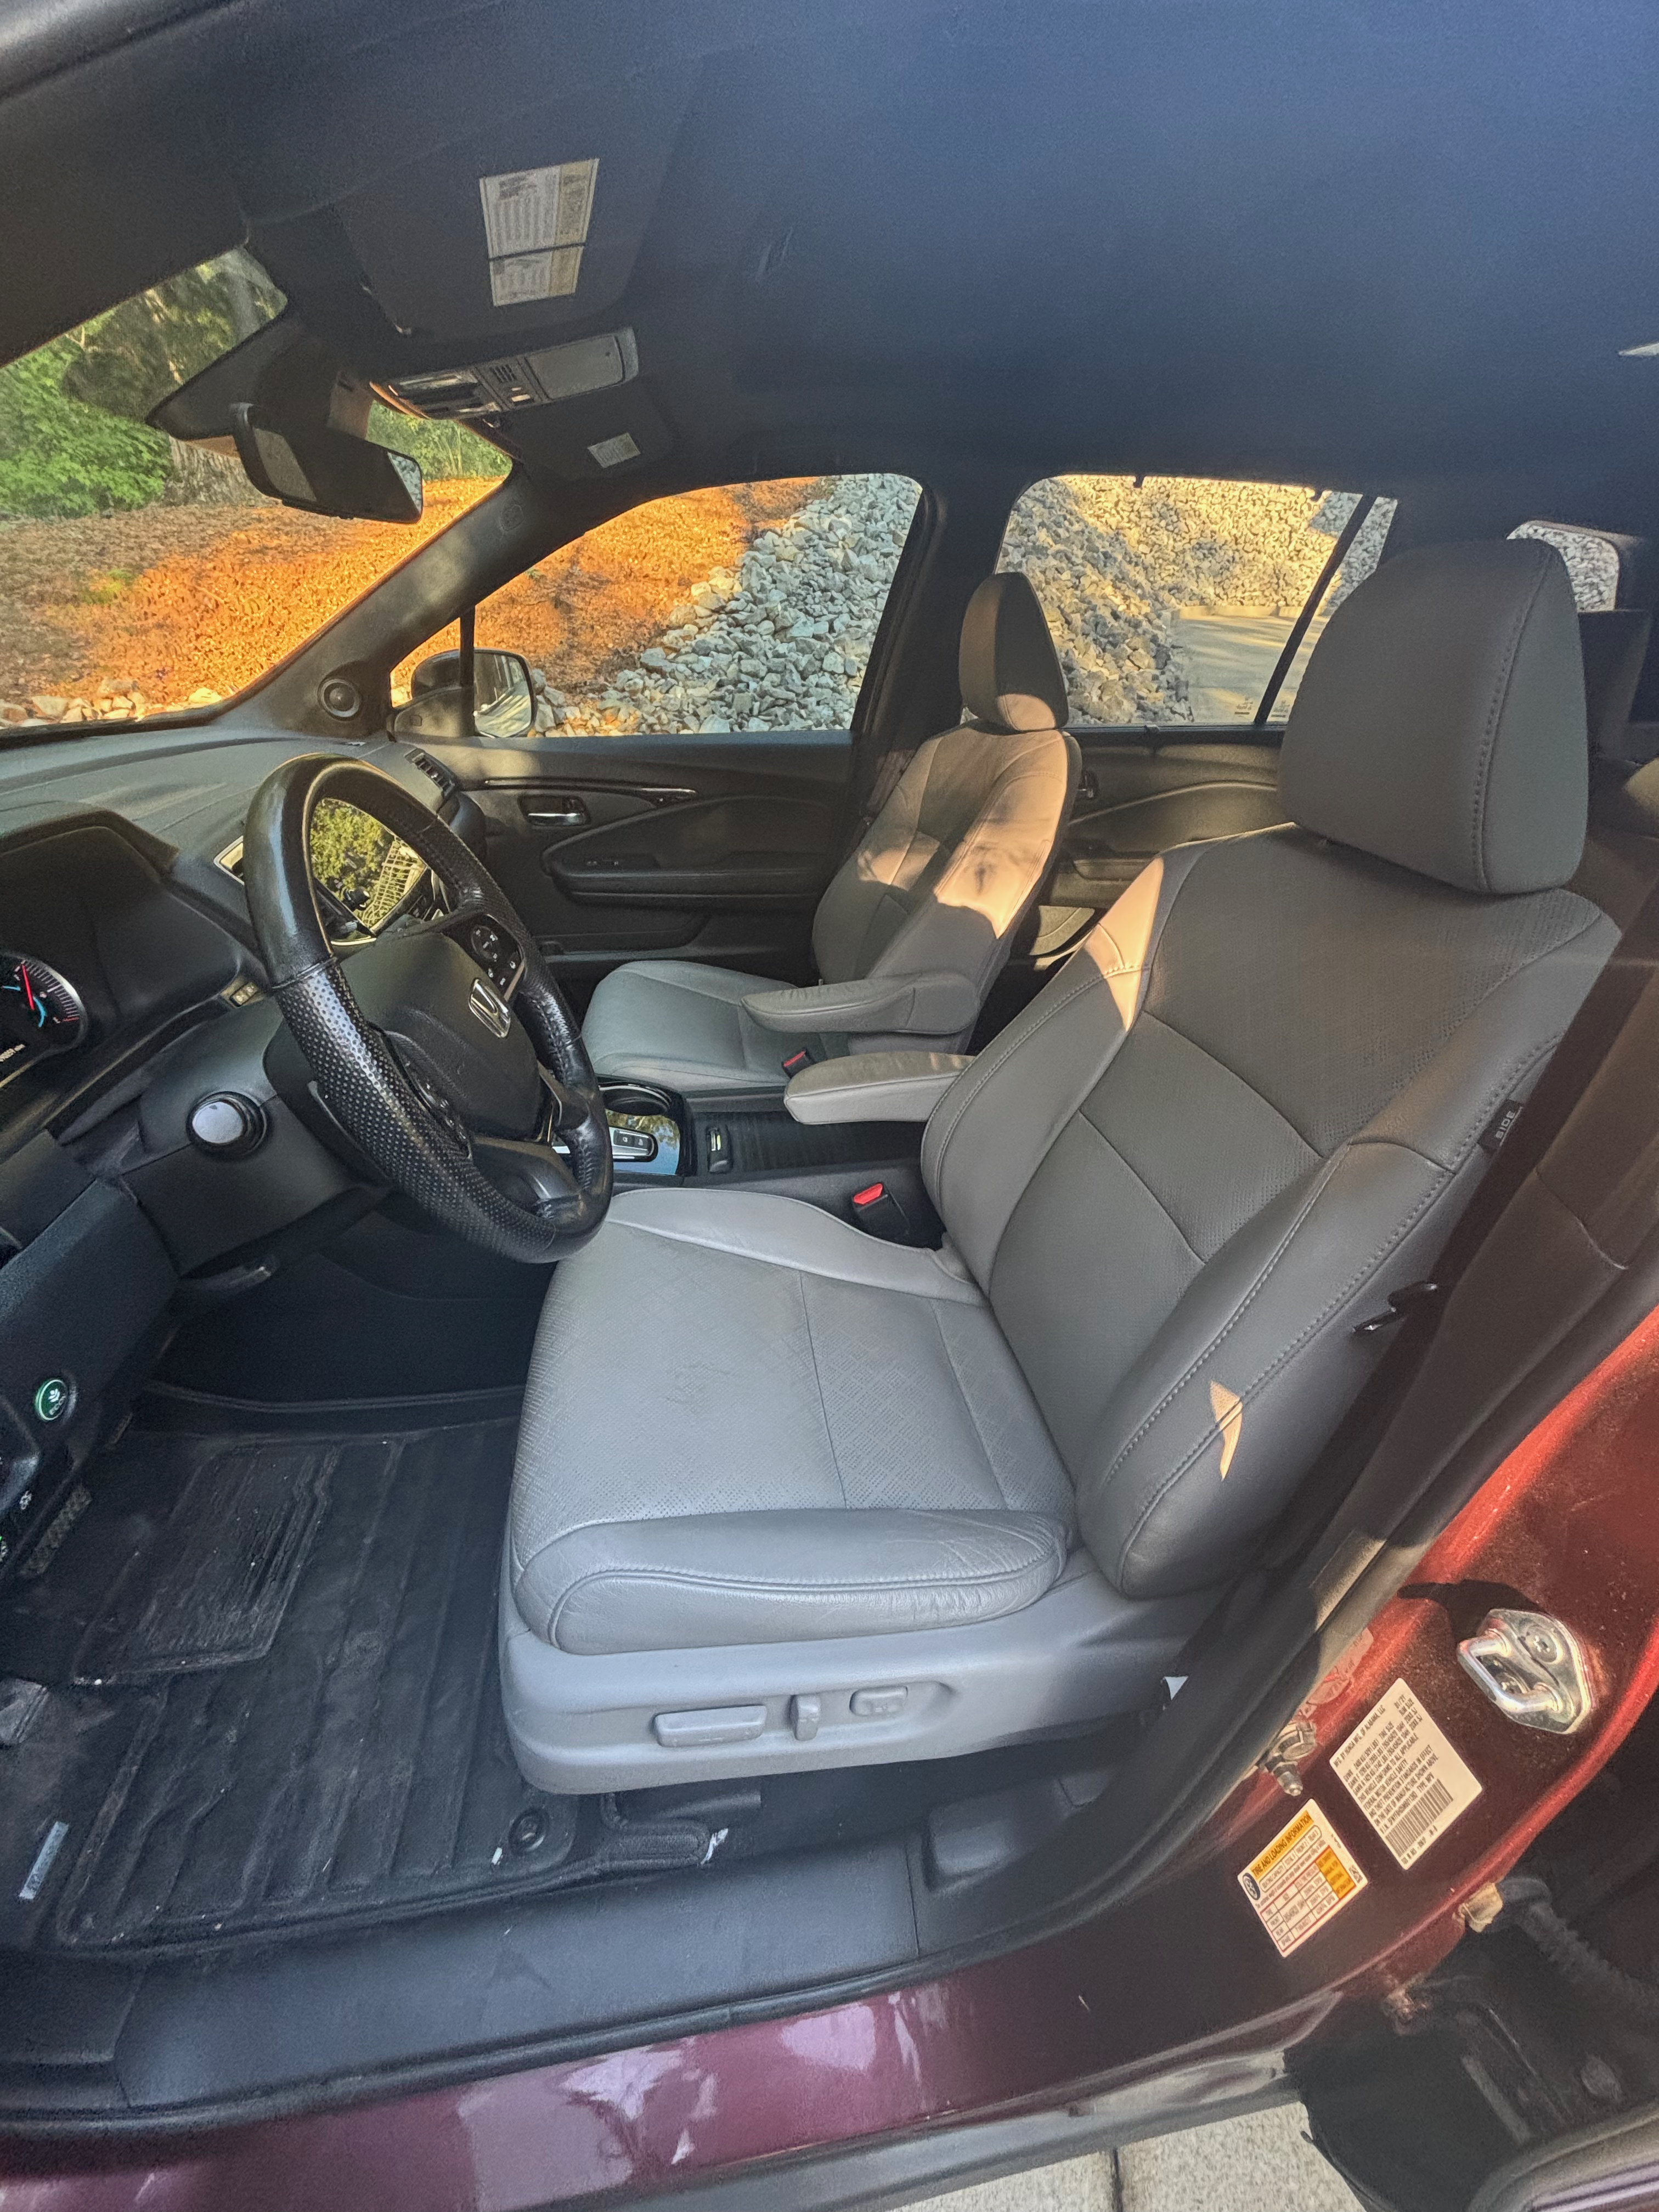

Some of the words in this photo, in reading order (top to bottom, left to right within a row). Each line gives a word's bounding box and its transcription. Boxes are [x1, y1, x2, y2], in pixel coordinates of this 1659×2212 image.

[1495, 1110, 1515, 1139] SIDE
[1385, 1722, 1393, 1732] SIZE
[1405, 1698, 1414, 1709] SIZE
[1344, 1740, 1355, 1754] HONDA
[1359, 1727, 1366, 1736] OF
[1377, 1705, 1385, 1715] LLC
[1363, 1794, 1376, 1810] FEDERAL
[1384, 1770, 1397, 1786] VEHICLE
[1395, 1758, 1408, 1774] SAFETY
[1364, 1780, 1377, 1796] VEHICLE
[1400, 1733, 1418, 1756] APPLICABLE
[1368, 1808, 1376, 1818] AND
[1374, 1798, 1385, 1812] THEFT
[1382, 1780, 1401, 1802] PREVENTION
[1399, 1761, 1418, 1784] STANDARDS
[1415, 1757, 1422, 1765] IN
[1419, 1745, 1433, 1760] EFFECT
[1383, 1803, 1393, 1815] DATE
[1390, 1799, 1397, 1807] OF
[1395, 1776, 1417, 1802] MANUFACTURE
[1414, 1764, 1428, 1780] SHOWN
[1417, 1780, 1426, 1792] TYPE
[1251, 1863, 1262, 1877] TIRE
[1260, 1854, 1271, 1869] AND
[1268, 1838, 1287, 1860] LOADING
[1284, 1813, 1312, 1843] INFORMATION
